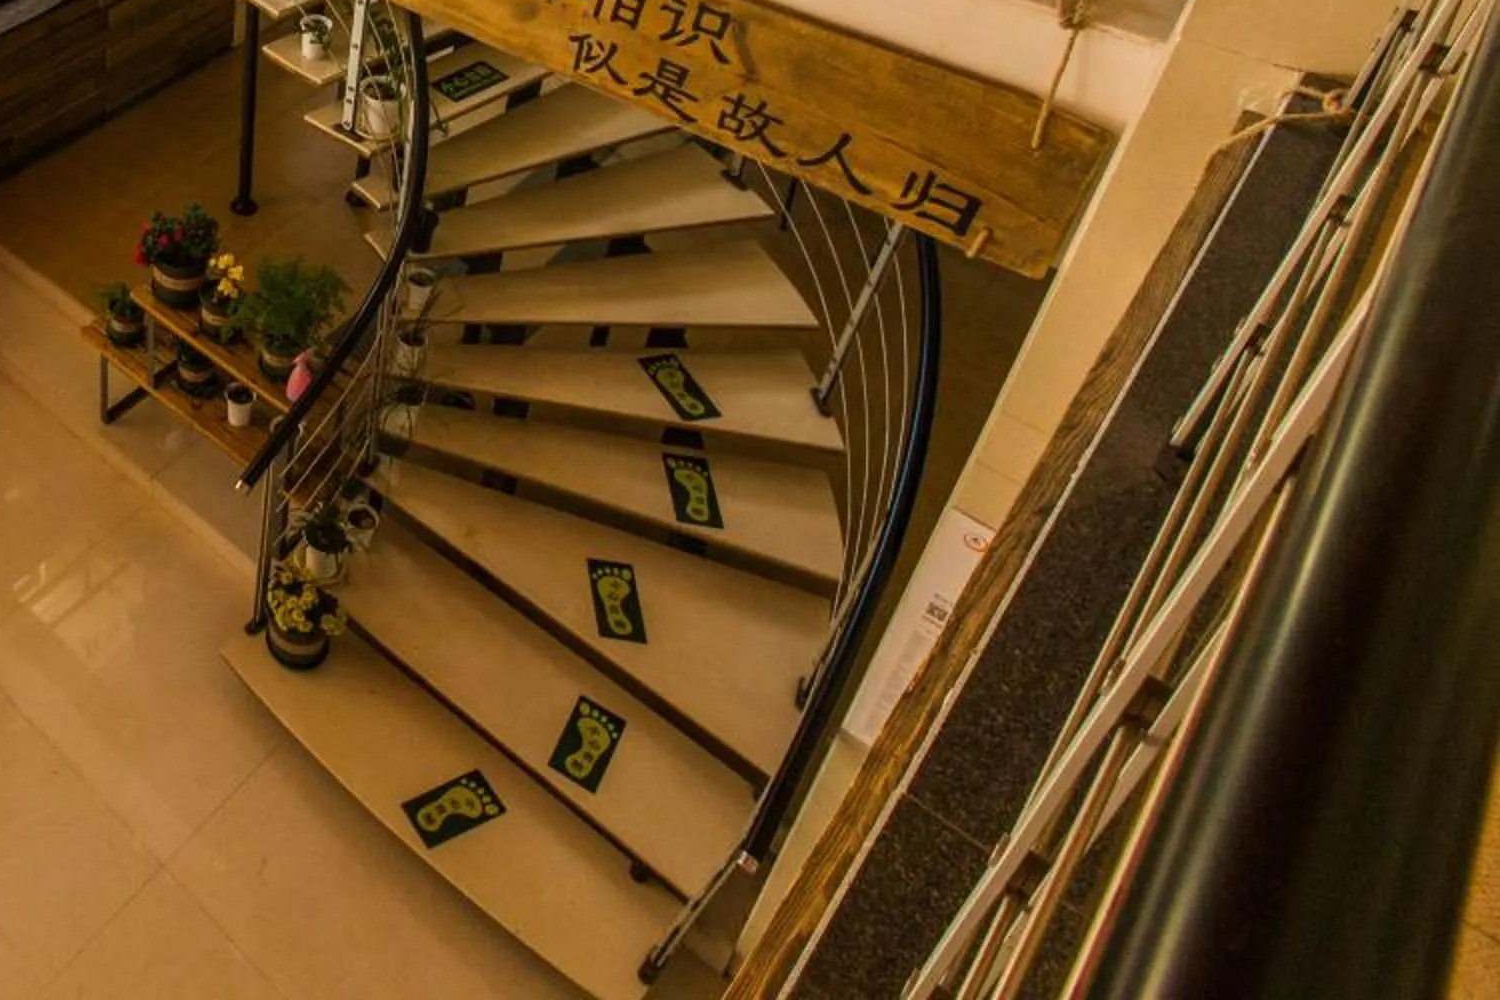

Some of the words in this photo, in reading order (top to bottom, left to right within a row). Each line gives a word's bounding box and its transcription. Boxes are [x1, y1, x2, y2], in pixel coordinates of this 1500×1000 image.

[567, 32, 981, 238] 似是故人归
